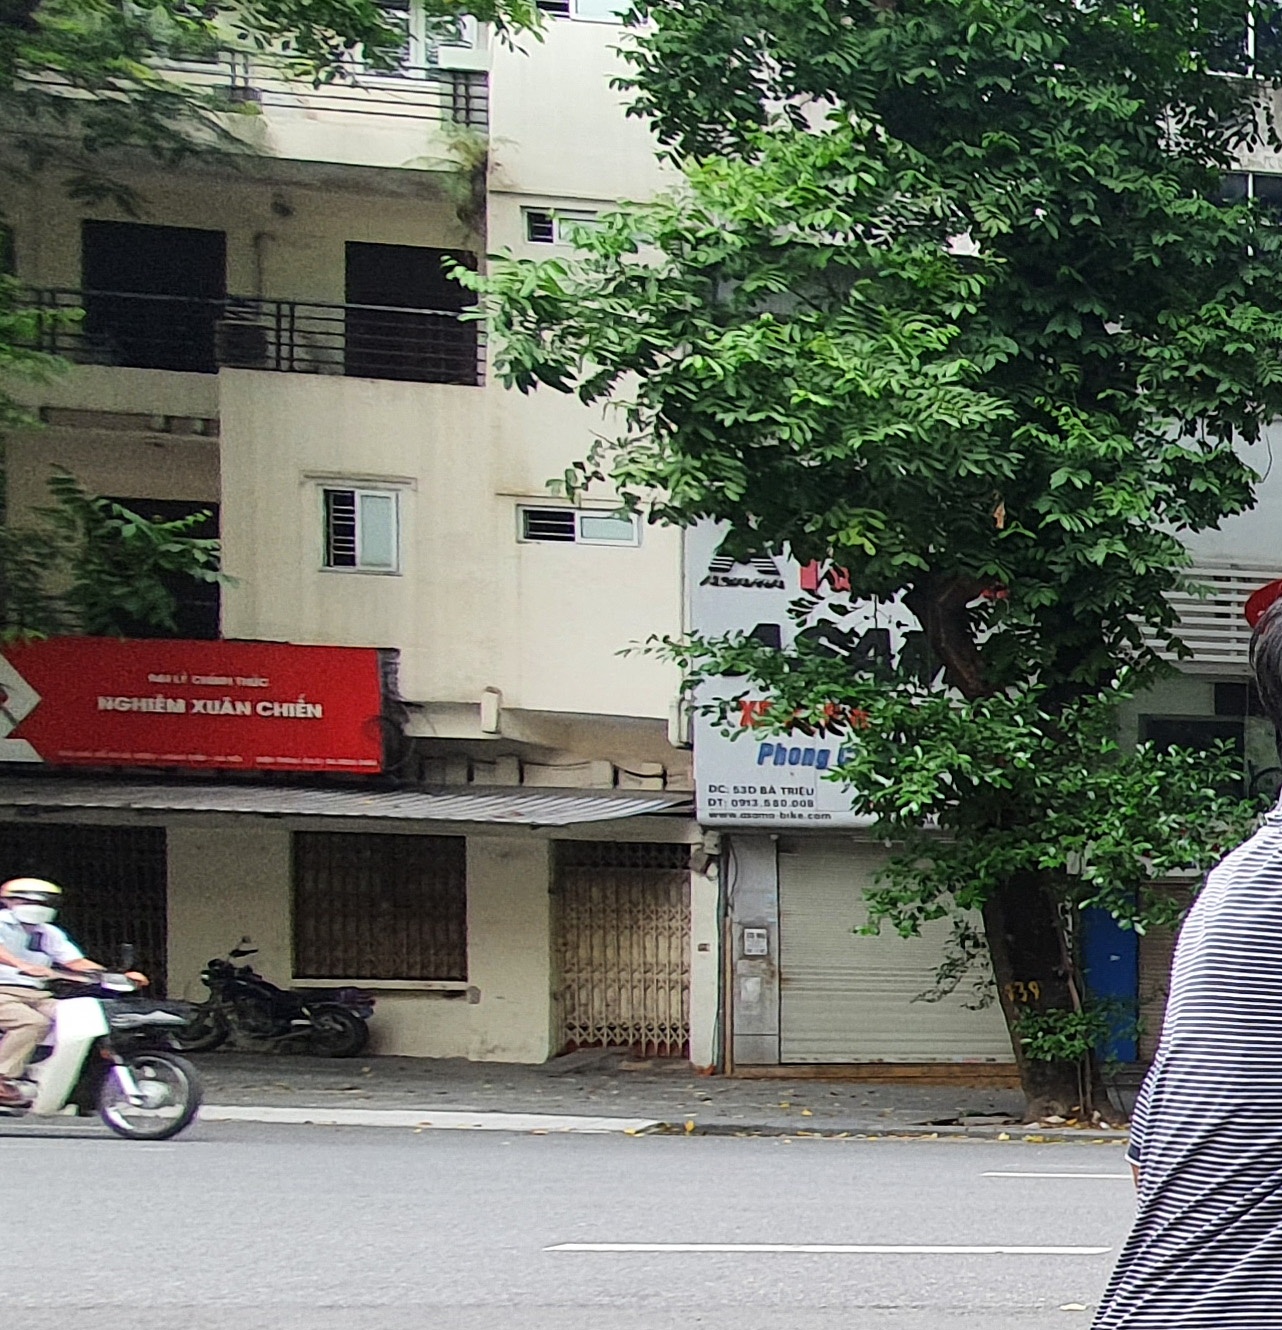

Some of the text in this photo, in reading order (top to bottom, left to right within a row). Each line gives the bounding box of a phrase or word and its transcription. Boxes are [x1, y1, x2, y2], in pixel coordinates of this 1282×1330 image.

[191, 695, 252, 717] XUÂN
[256, 692, 323, 719] CHIẾN
[757, 742, 831, 770] Phong
[760, 785, 777, 795] BÀ
